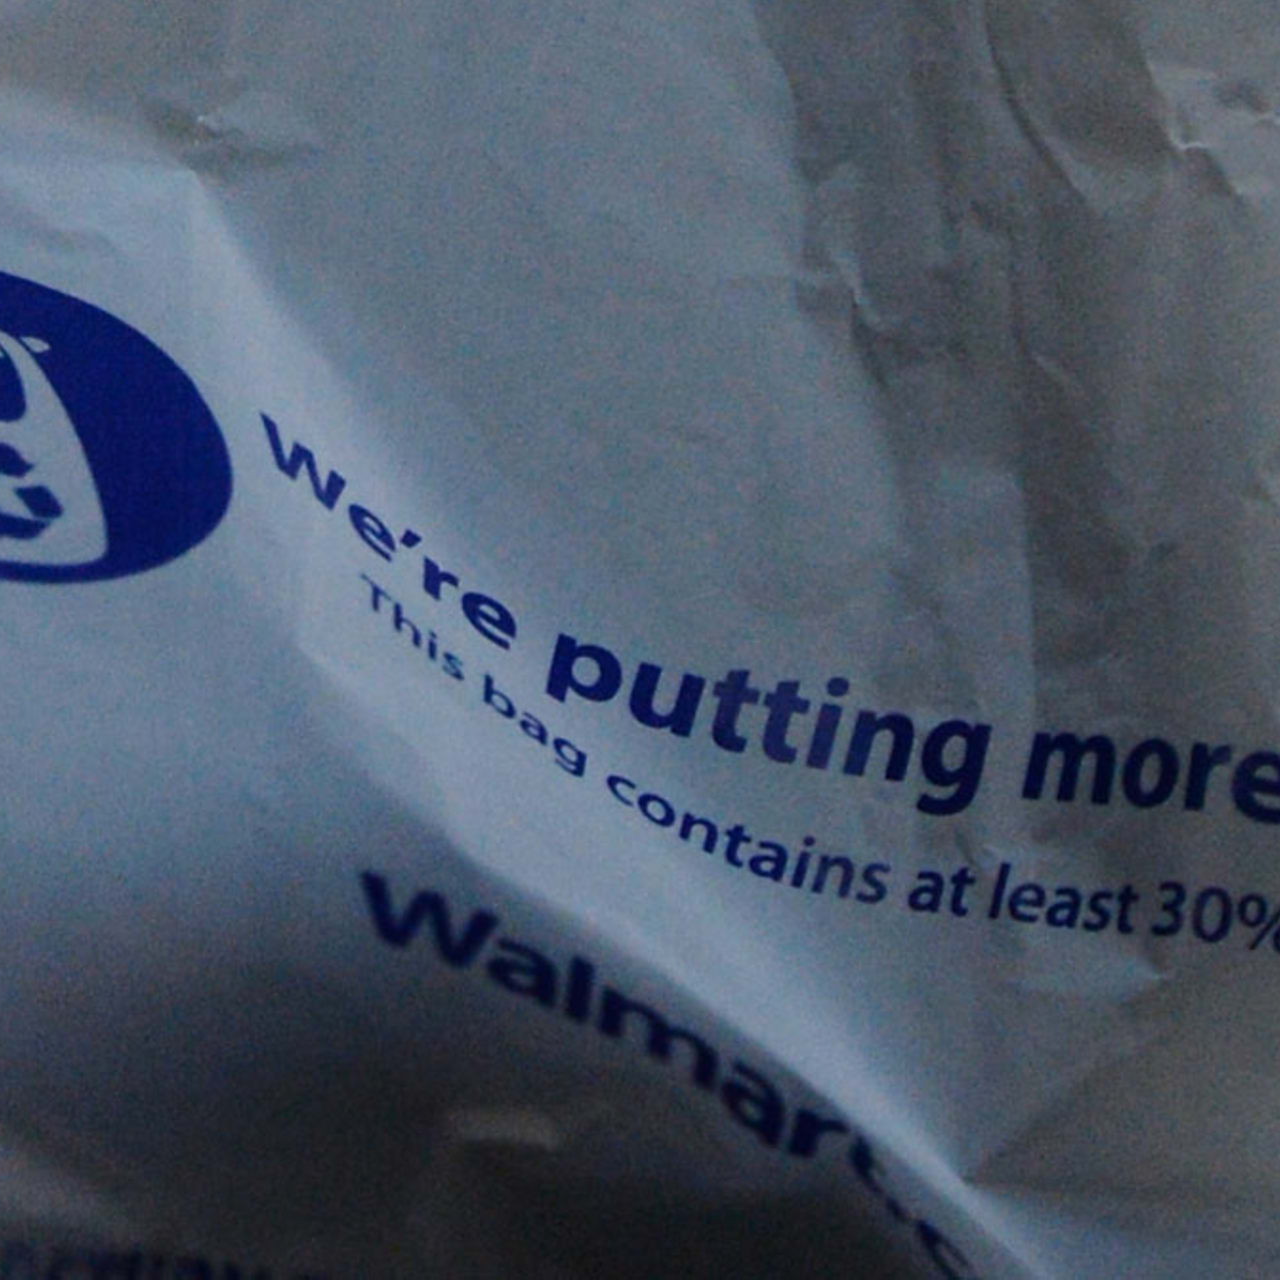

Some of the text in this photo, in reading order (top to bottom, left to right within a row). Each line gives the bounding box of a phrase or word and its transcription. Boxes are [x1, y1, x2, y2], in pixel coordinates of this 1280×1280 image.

[260, 412, 518, 650] We're
[545, 632, 995, 818] putting
[359, 573, 466, 682] This
[482, 673, 589, 779] bag
[606, 774, 892, 905] contains
[907, 866, 978, 918] at
[986, 861, 1142, 937] least
